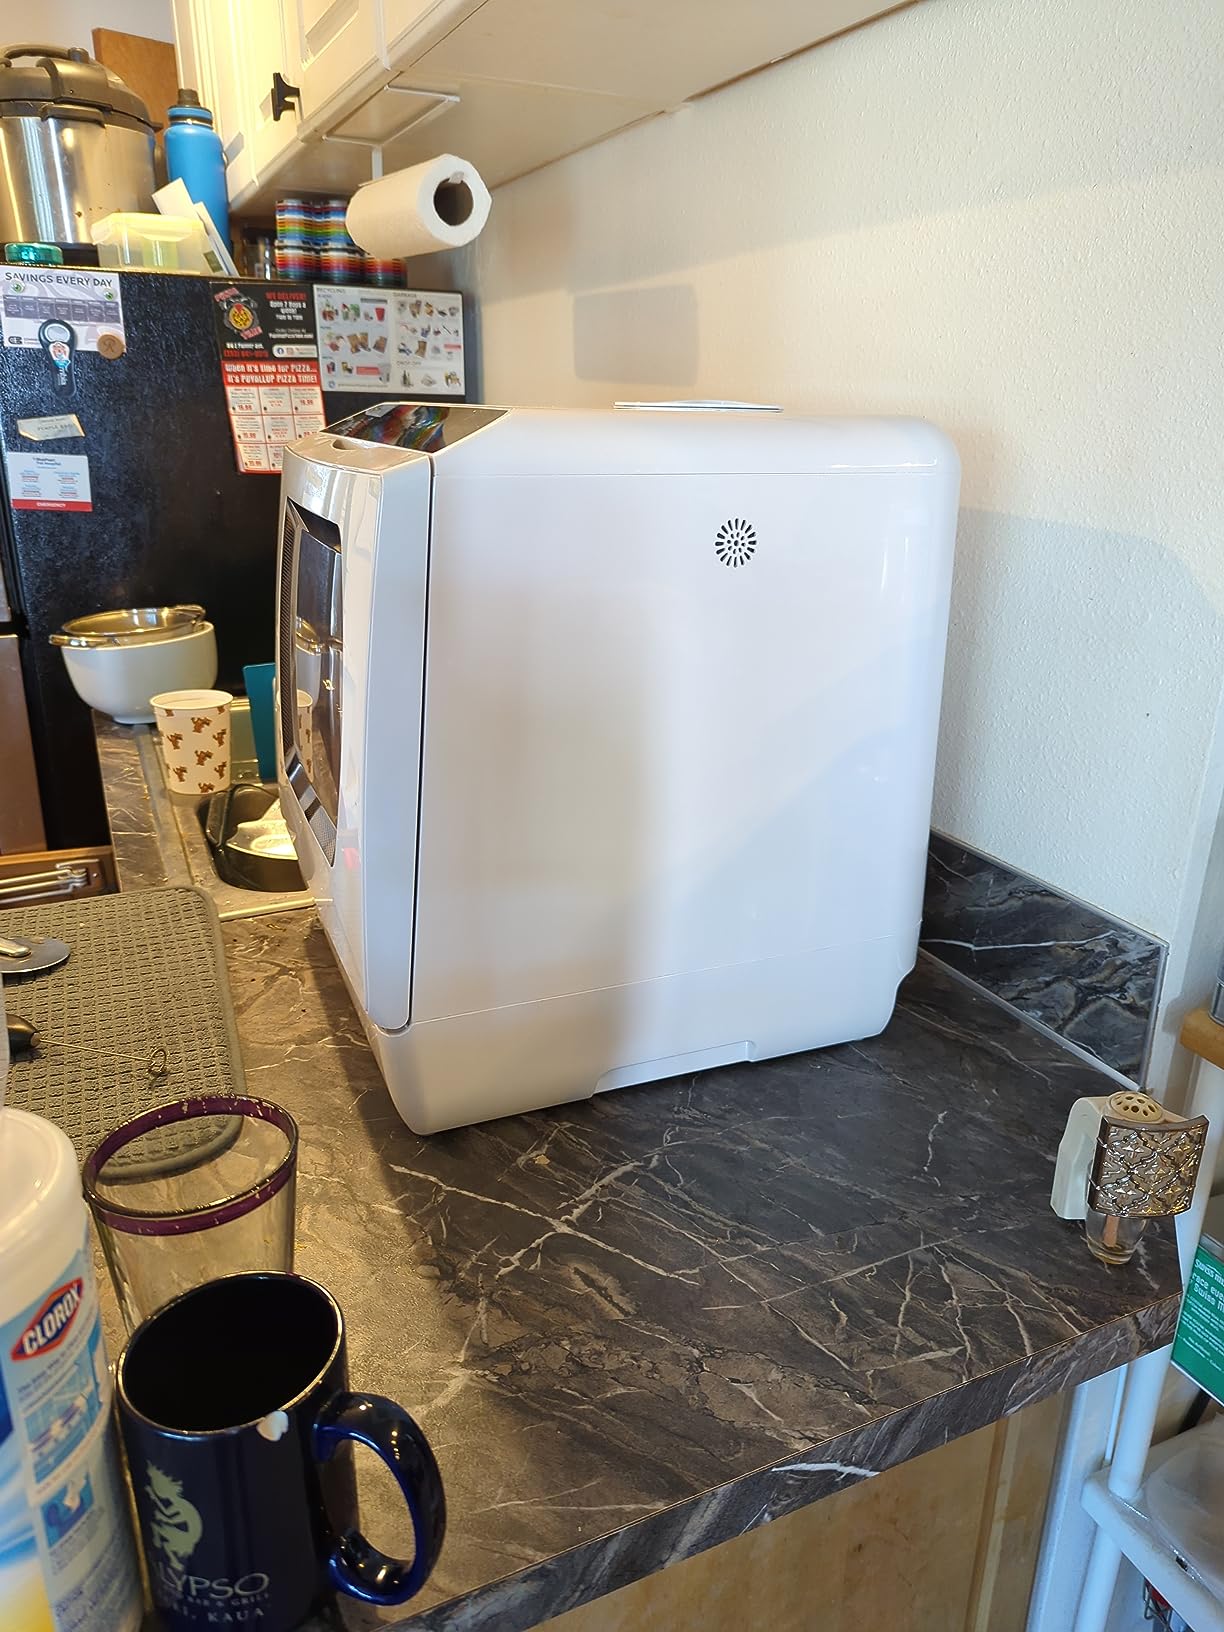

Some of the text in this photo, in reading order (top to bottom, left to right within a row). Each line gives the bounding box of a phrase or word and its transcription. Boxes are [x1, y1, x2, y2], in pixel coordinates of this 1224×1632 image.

[5, 272, 113, 288] SAVINGS EVERY DAY
[225, 364, 246, 373] When
[260, 364, 277, 373] time
[278, 364, 290, 373] for
[240, 374, 276, 383] PUYALLUP
[277, 374, 297, 383] PIZZA
[298, 375, 318, 383] TIME!
[1193, 1283, 1216, 1306] Swiss
[22, 1282, 81, 1356] CLOROX
